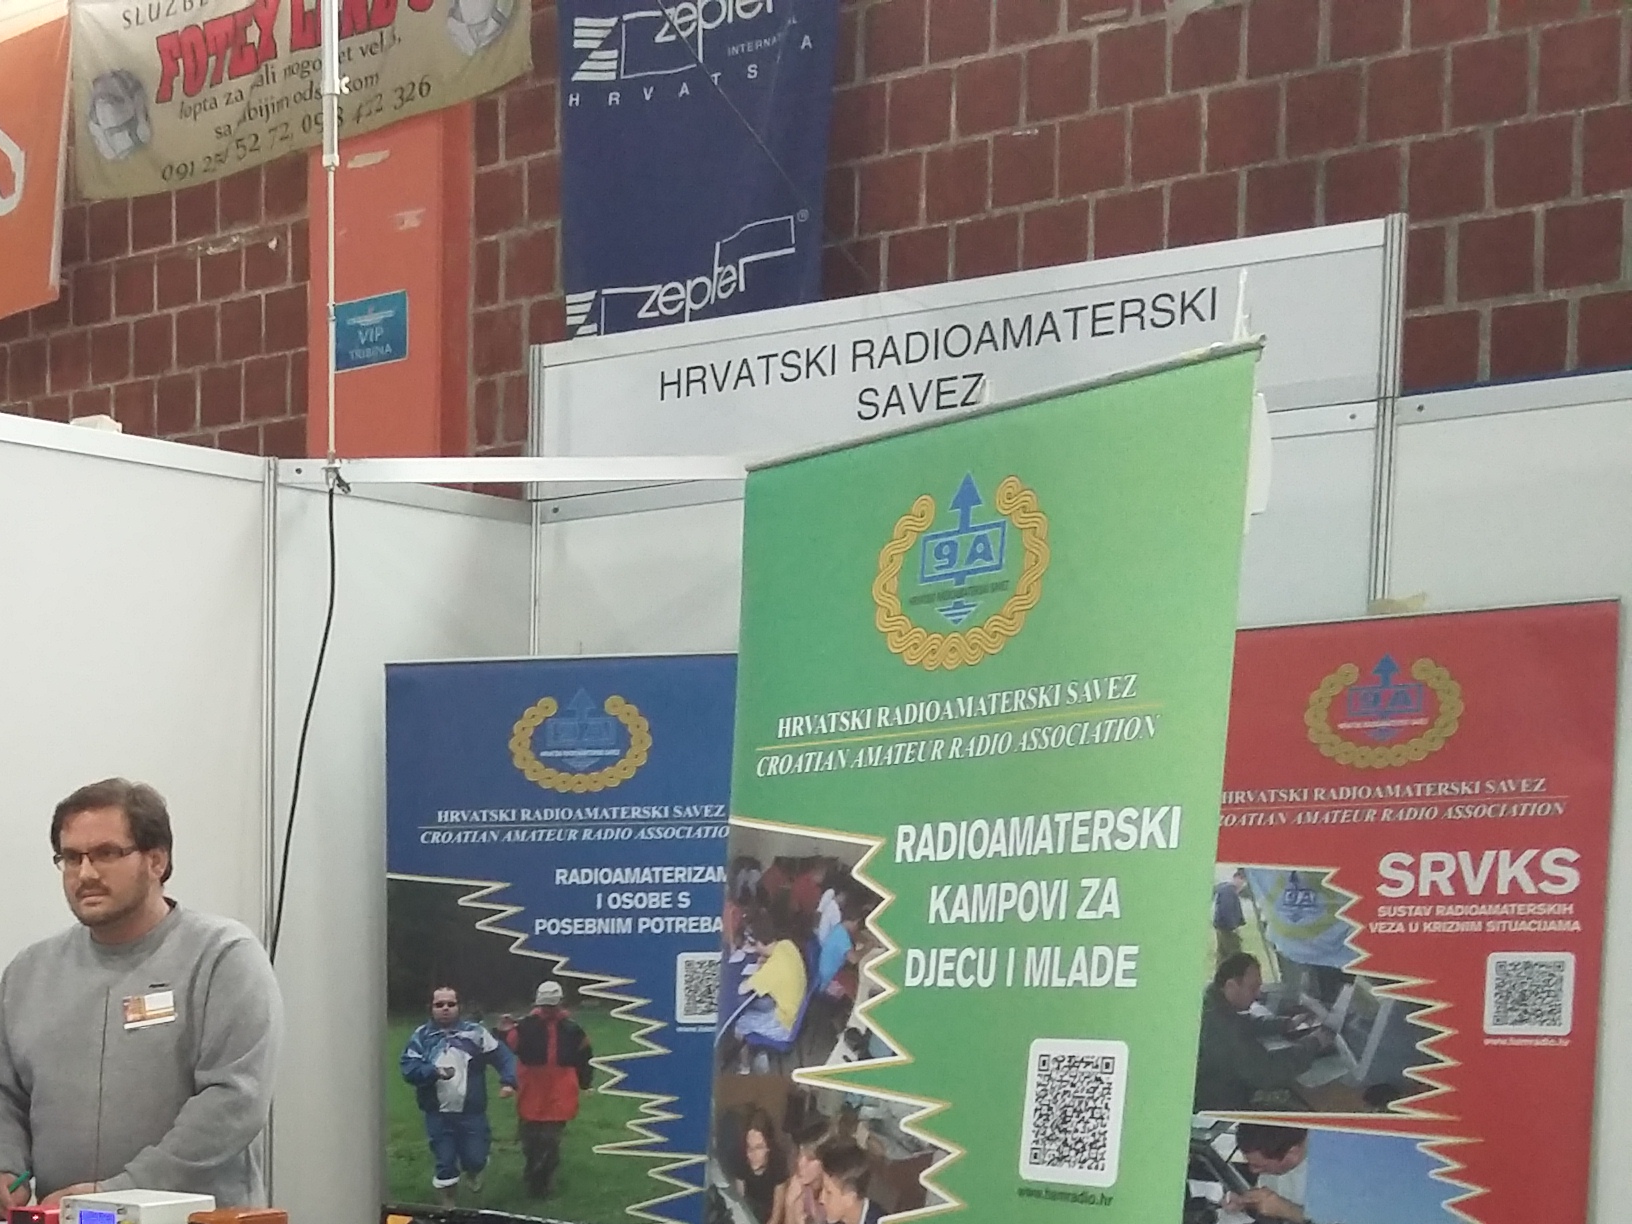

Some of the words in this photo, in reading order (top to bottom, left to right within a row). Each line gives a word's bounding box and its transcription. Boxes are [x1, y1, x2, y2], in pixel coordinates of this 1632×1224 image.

[179, 97, 218, 121] lopta
[225, 89, 244, 106] za
[250, 62, 276, 92] ali
[283, 47, 353, 79] nogoet
[394, 74, 432, 110] 326
[215, 124, 232, 139] sa
[357, 326, 384, 345] VIP
[660, 343, 837, 401] HRVATSKI
[852, 286, 1217, 373] RADIOAMATERSKI
[857, 373, 985, 421] SAVEZ
[933, 534, 995, 570] 9A
[777, 708, 871, 740] HRVATSKI
[876, 683, 1061, 728] RADIOAMATERSKI
[1067, 674, 1139, 705] SAVEZ
[756, 747, 847, 778] CROATIAN
[851, 737, 943, 771] AMATEUR
[948, 730, 1012, 760] RADIO
[1014, 714, 1162, 752] ASSOCIATION
[1222, 788, 1309, 804] HRVATSKI
[1313, 781, 1480, 802] RADIOAMATERSKI
[1485, 777, 1547, 794] SAVEZ
[437, 808, 517, 824] HRVATSKI
[520, 805, 669, 823] RADIOAMATERSKI
[672, 804, 726, 818] SAVEZ
[1291, 808, 1377, 826] AMATEUR
[1380, 806, 1438, 822] RADIO
[1442, 801, 1565, 820] ASSOCIATION
[420, 829, 498, 845] CROATIAN
[501, 828, 578, 843] AMATEUR
[581, 827, 632, 842] RADIO
[635, 825, 730, 840] ASSOCIATIO
[895, 805, 1183, 864] RADIOAMATERSKI
[1376, 847, 1581, 899] SRVKS
[596, 894, 601, 910] I
[607, 893, 673, 910] OSOBE
[677, 892, 691, 909] S
[928, 879, 1068, 924] KAMPOVI
[1076, 877, 1121, 920] ZA
[1378, 905, 1432, 917] SUSTAV
[1436, 903, 1574, 916] RADIOAMATERSKIH
[534, 917, 632, 935] POSEBNIM
[638, 916, 723, 934] POTREBA
[1369, 921, 1405, 933] VEZA
[1408, 922, 1419, 932] U
[904, 947, 997, 988] DJECU
[1006, 947, 1016, 988] I
[1024, 945, 1140, 988] MLADE
